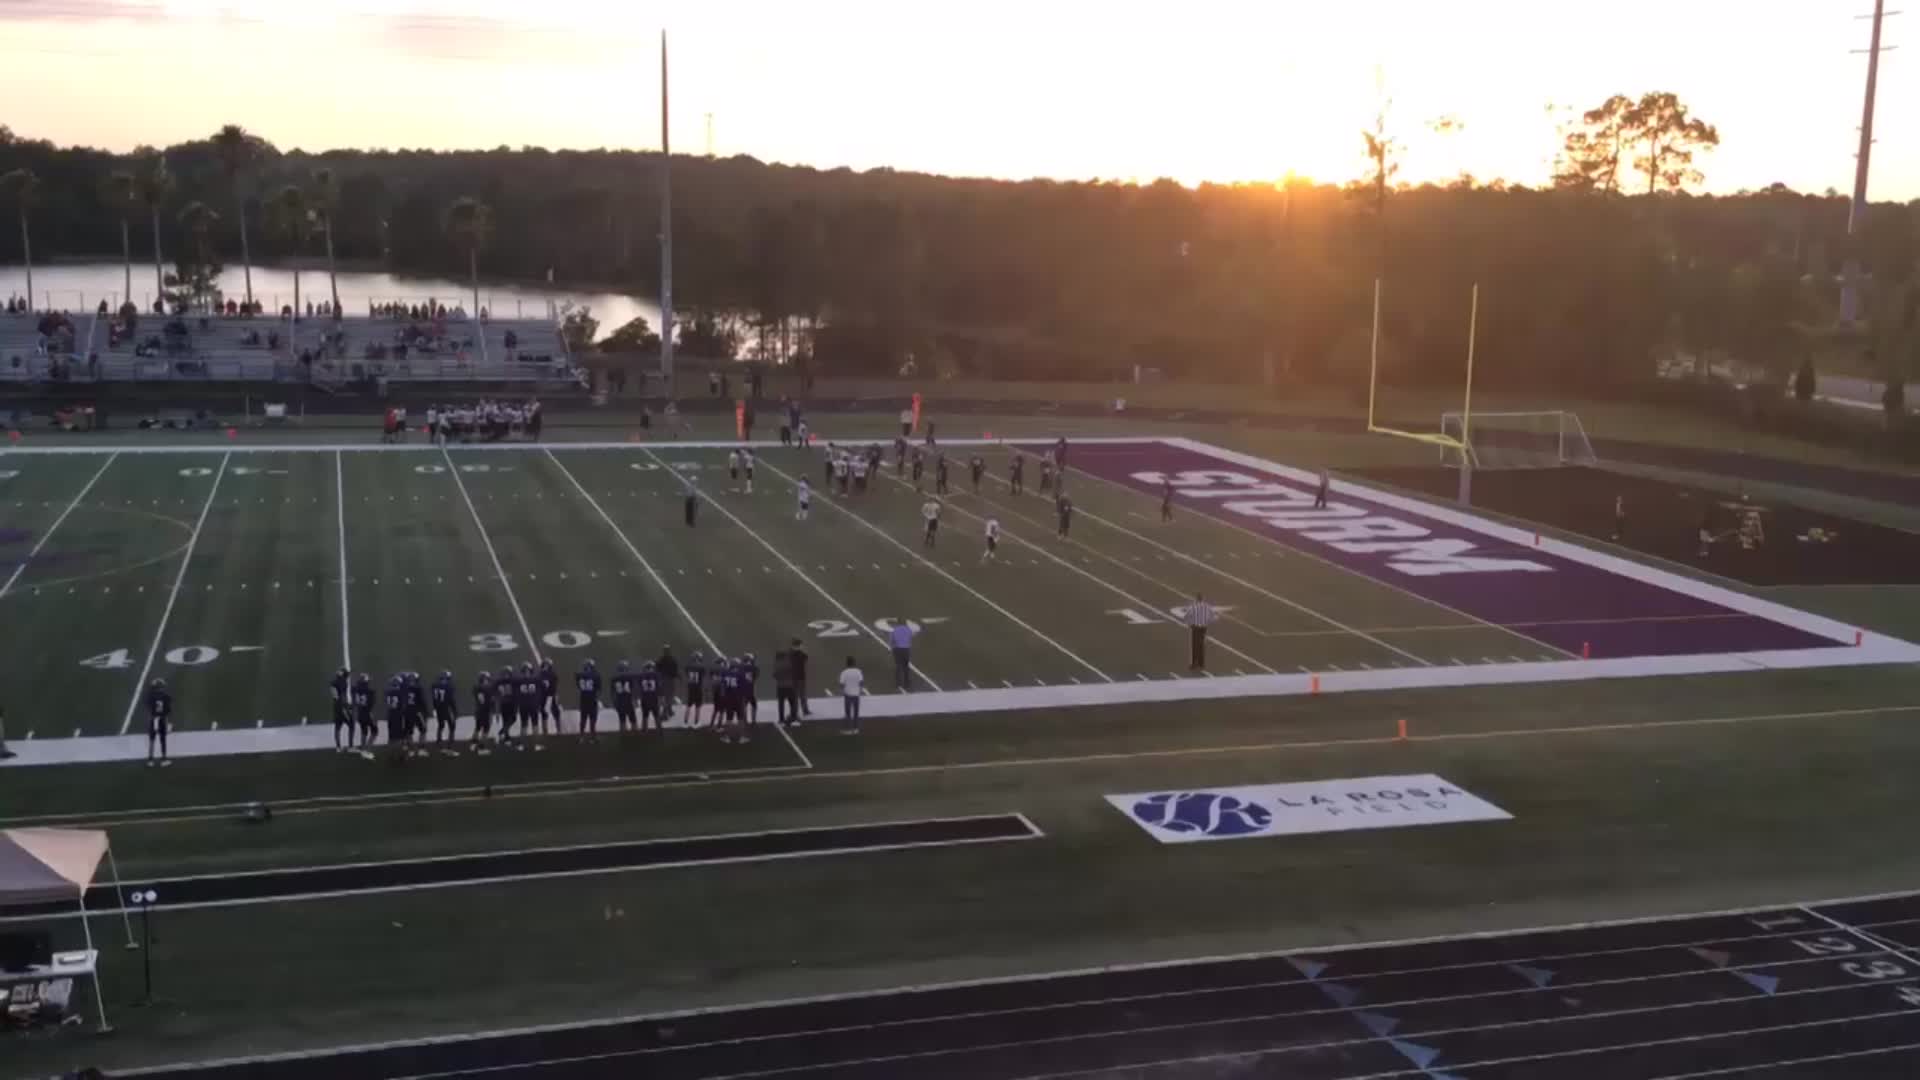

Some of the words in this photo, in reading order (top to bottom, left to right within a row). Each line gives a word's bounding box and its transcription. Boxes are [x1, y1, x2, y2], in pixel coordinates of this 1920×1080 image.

[1129, 469, 1555, 577] STORM
[468, 630, 593, 651] 30
[79, 645, 220, 669] 40
[1277, 794, 1336, 807] LA
[1345, 786, 1463, 802] ROSA
[1326, 801, 1448, 816] FIELD
[1750, 914, 1806, 930] 1
[1791, 936, 1857, 955] 2
[1841, 960, 1907, 979] 3
